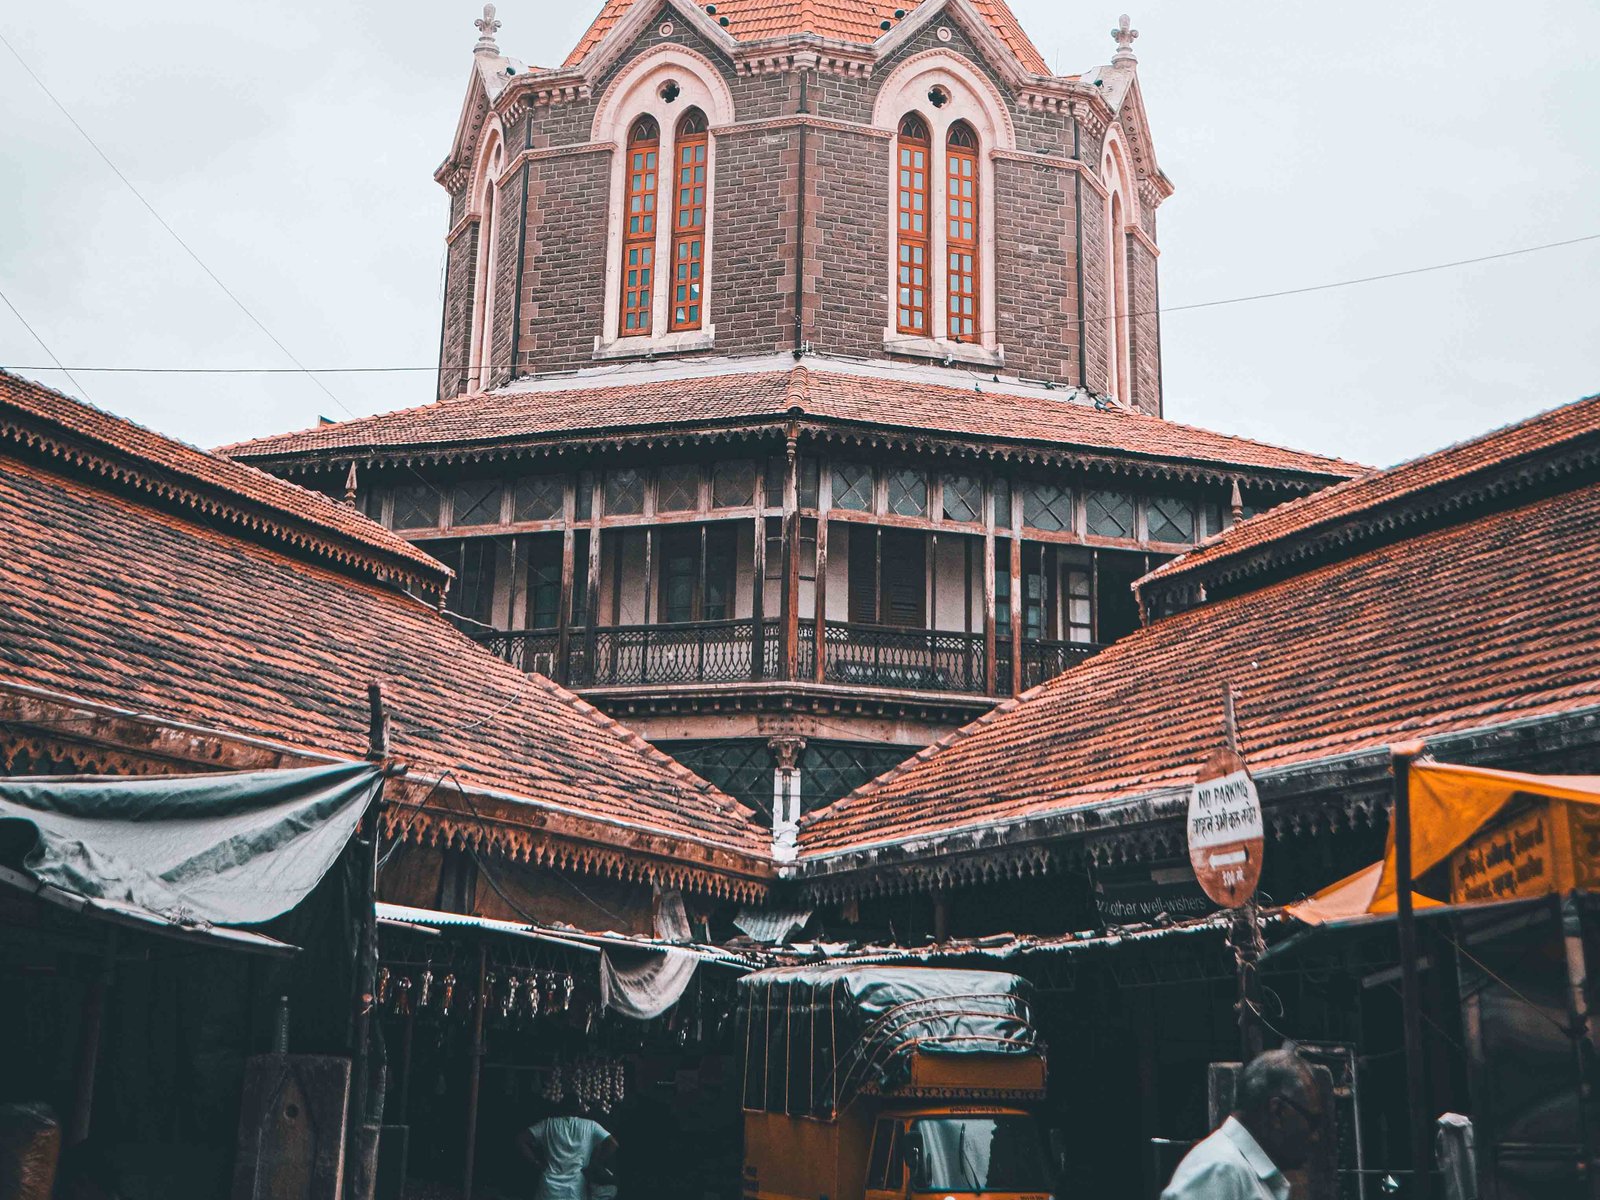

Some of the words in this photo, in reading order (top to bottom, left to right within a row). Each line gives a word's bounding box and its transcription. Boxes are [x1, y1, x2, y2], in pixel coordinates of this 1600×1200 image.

[1198, 790, 1211, 809] NO
[1214, 781, 1248, 803] PARKING
[1140, 896, 1206, 915] well-wishers
